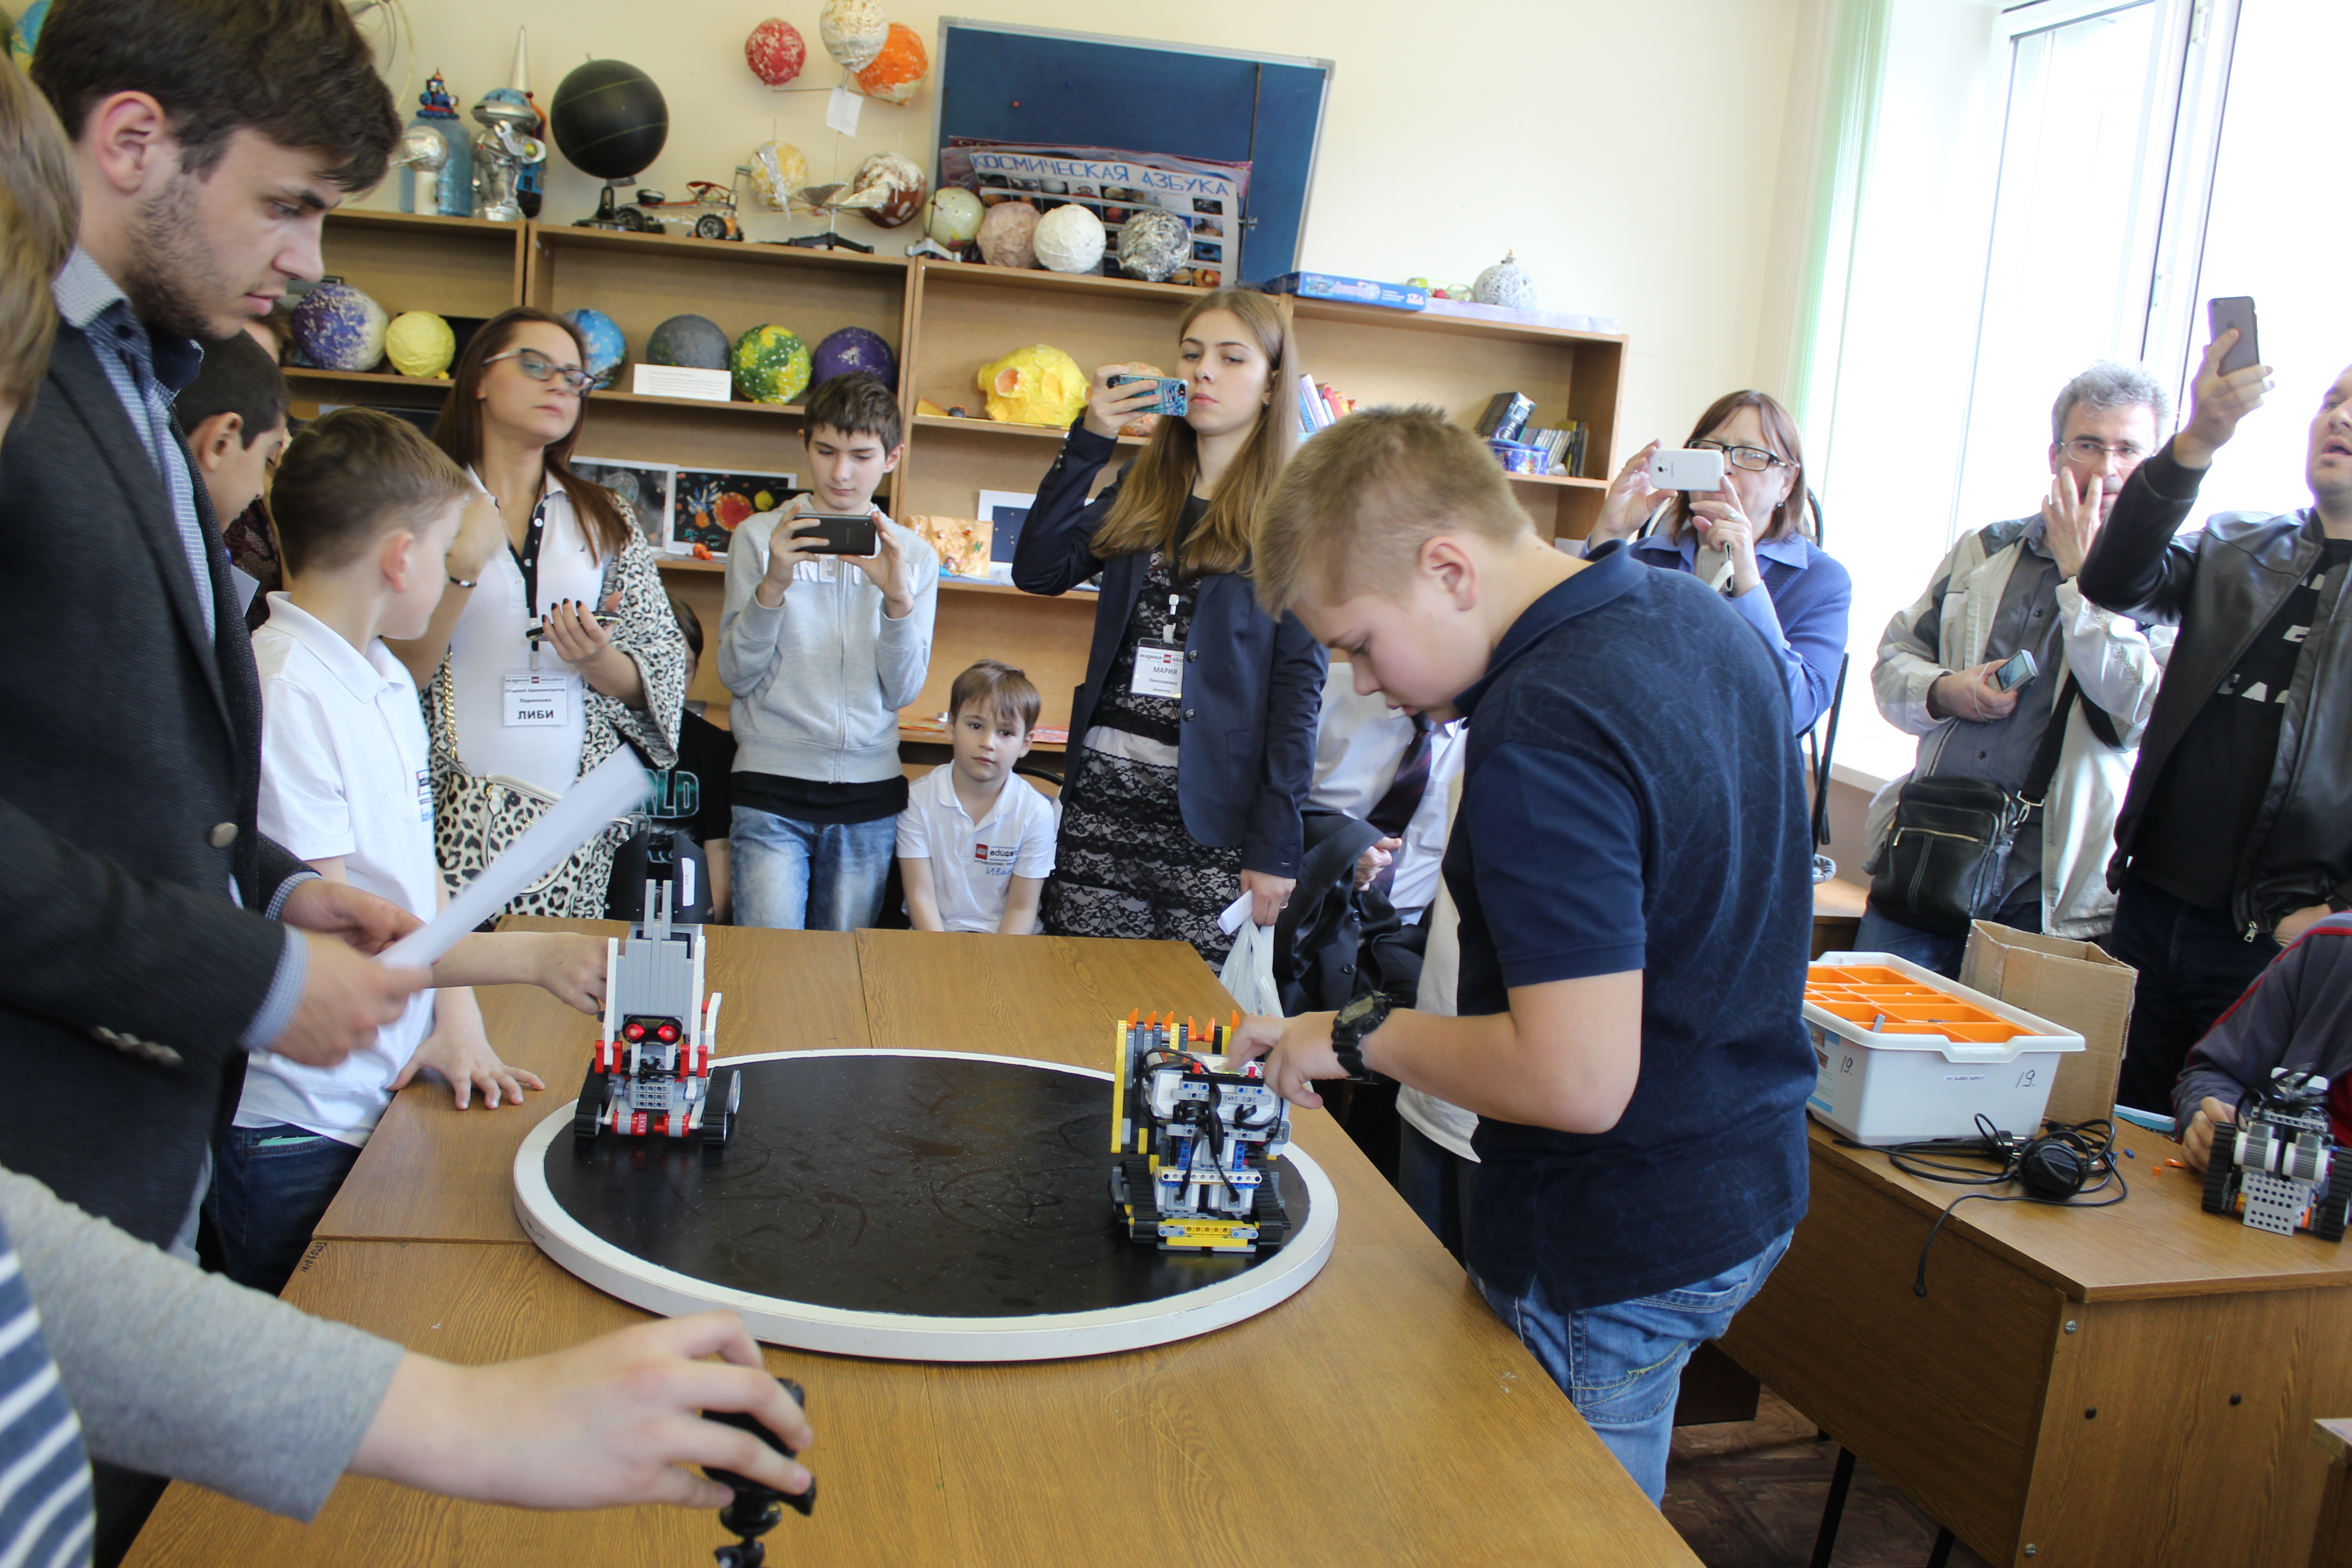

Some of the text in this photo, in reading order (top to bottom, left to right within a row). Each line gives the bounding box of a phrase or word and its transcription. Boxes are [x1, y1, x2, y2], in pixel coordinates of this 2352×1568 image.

[971, 154, 1230, 196] КОСМИЧЕСКАЯ АЗБУКА
[1153, 666, 1178, 675] МАРИЯ
[518, 710, 554, 720] ЛИБИ
[2015, 1069, 2035, 1089] 19.
